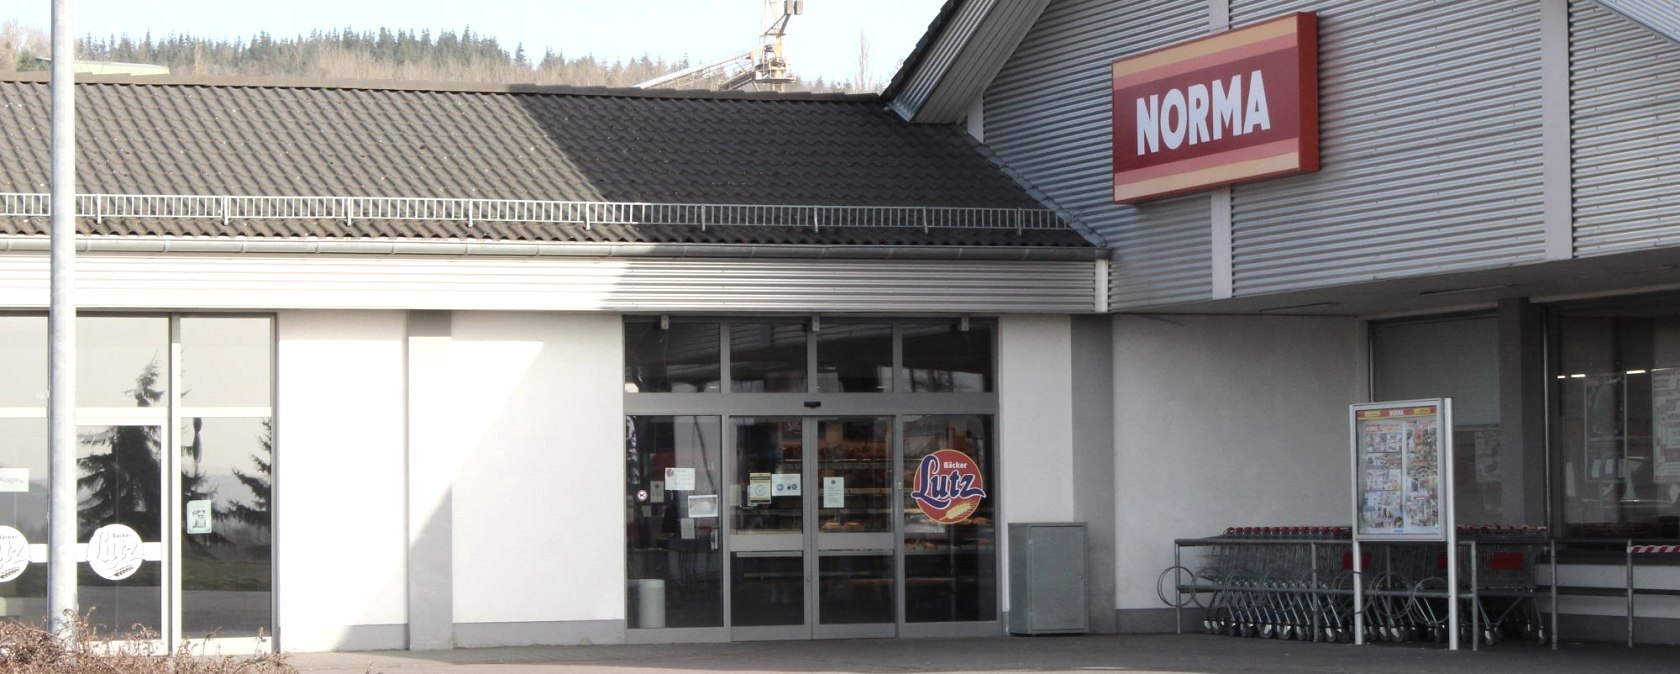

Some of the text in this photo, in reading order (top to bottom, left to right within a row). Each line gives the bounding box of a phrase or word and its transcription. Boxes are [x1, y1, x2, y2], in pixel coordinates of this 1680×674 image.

[1136, 70, 1271, 156] NORMA
[911, 454, 987, 510] Lutz
[943, 461, 968, 469] Bäcker
